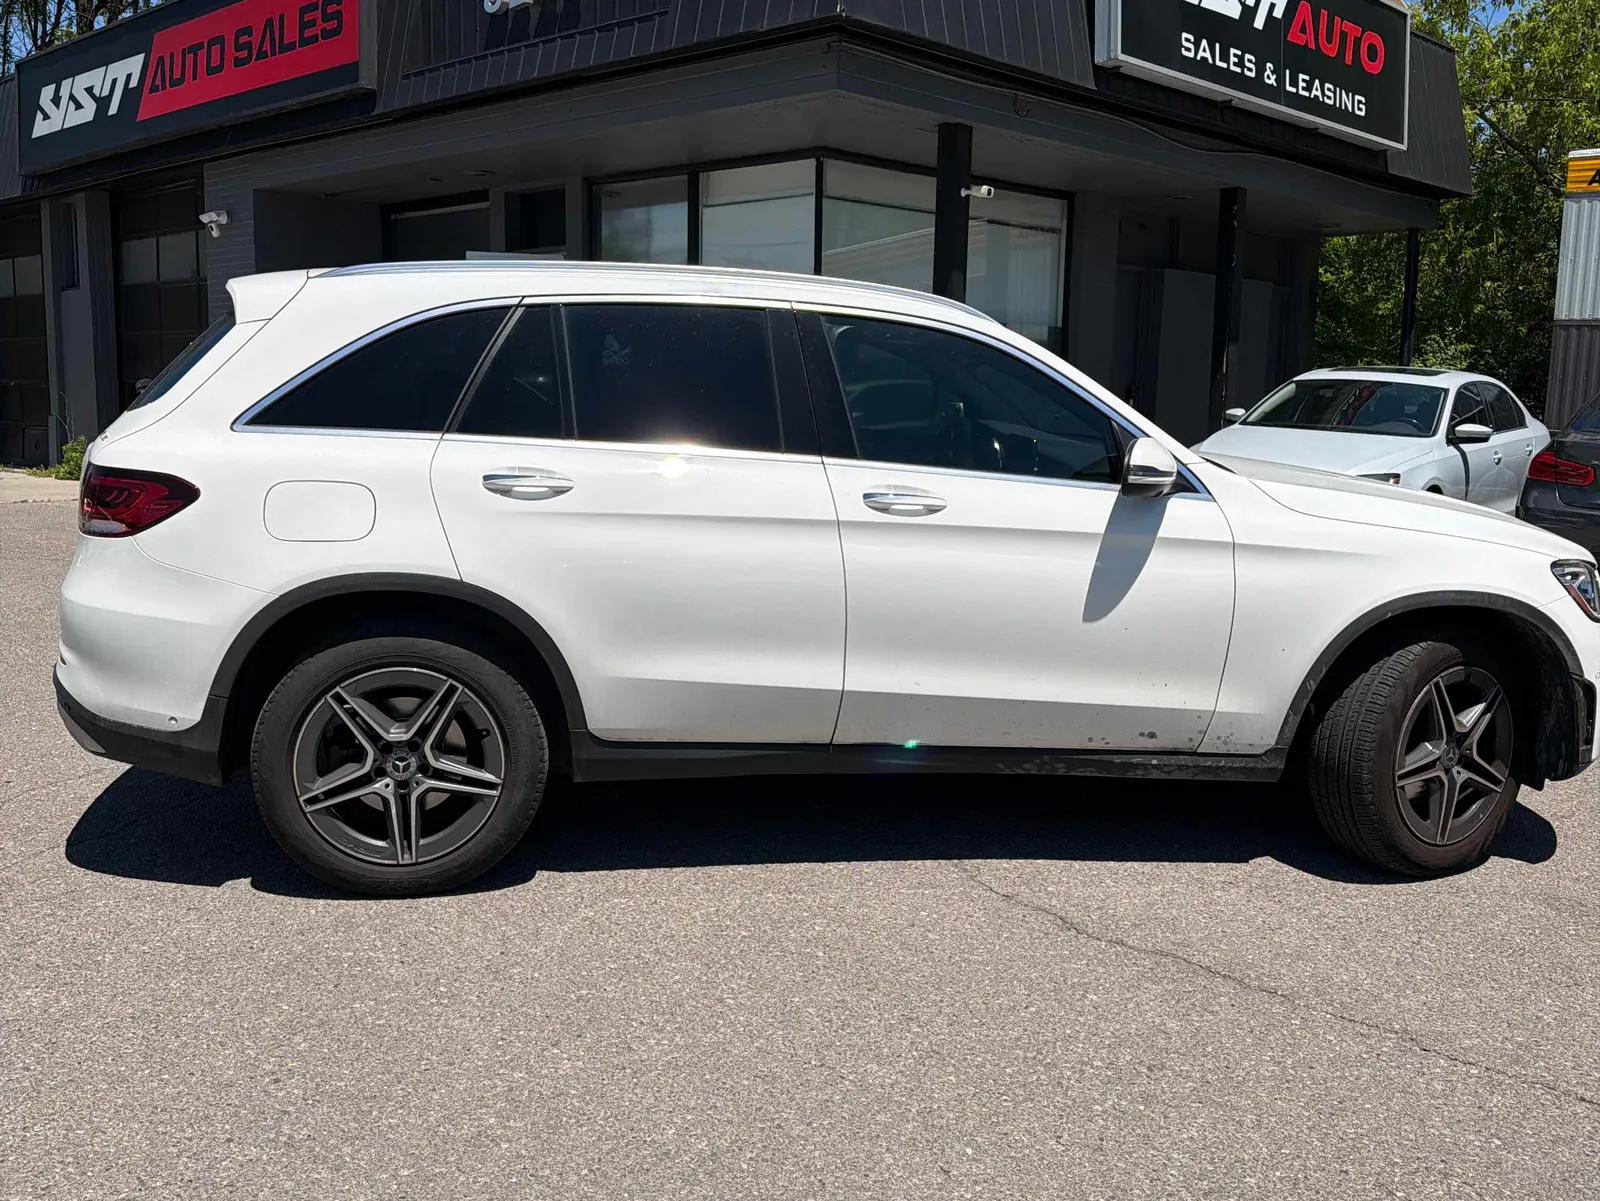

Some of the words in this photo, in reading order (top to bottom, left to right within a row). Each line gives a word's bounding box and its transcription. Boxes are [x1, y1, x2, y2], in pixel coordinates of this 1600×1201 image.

[149, 34, 226, 95] AUTO
[233, 0, 344, 69] SALES
[1181, 31, 1256, 78] SALES
[1263, 62, 1277, 87] &
[1285, 68, 1367, 117] LEASING
[1286, 2, 1386, 75] AUTO
